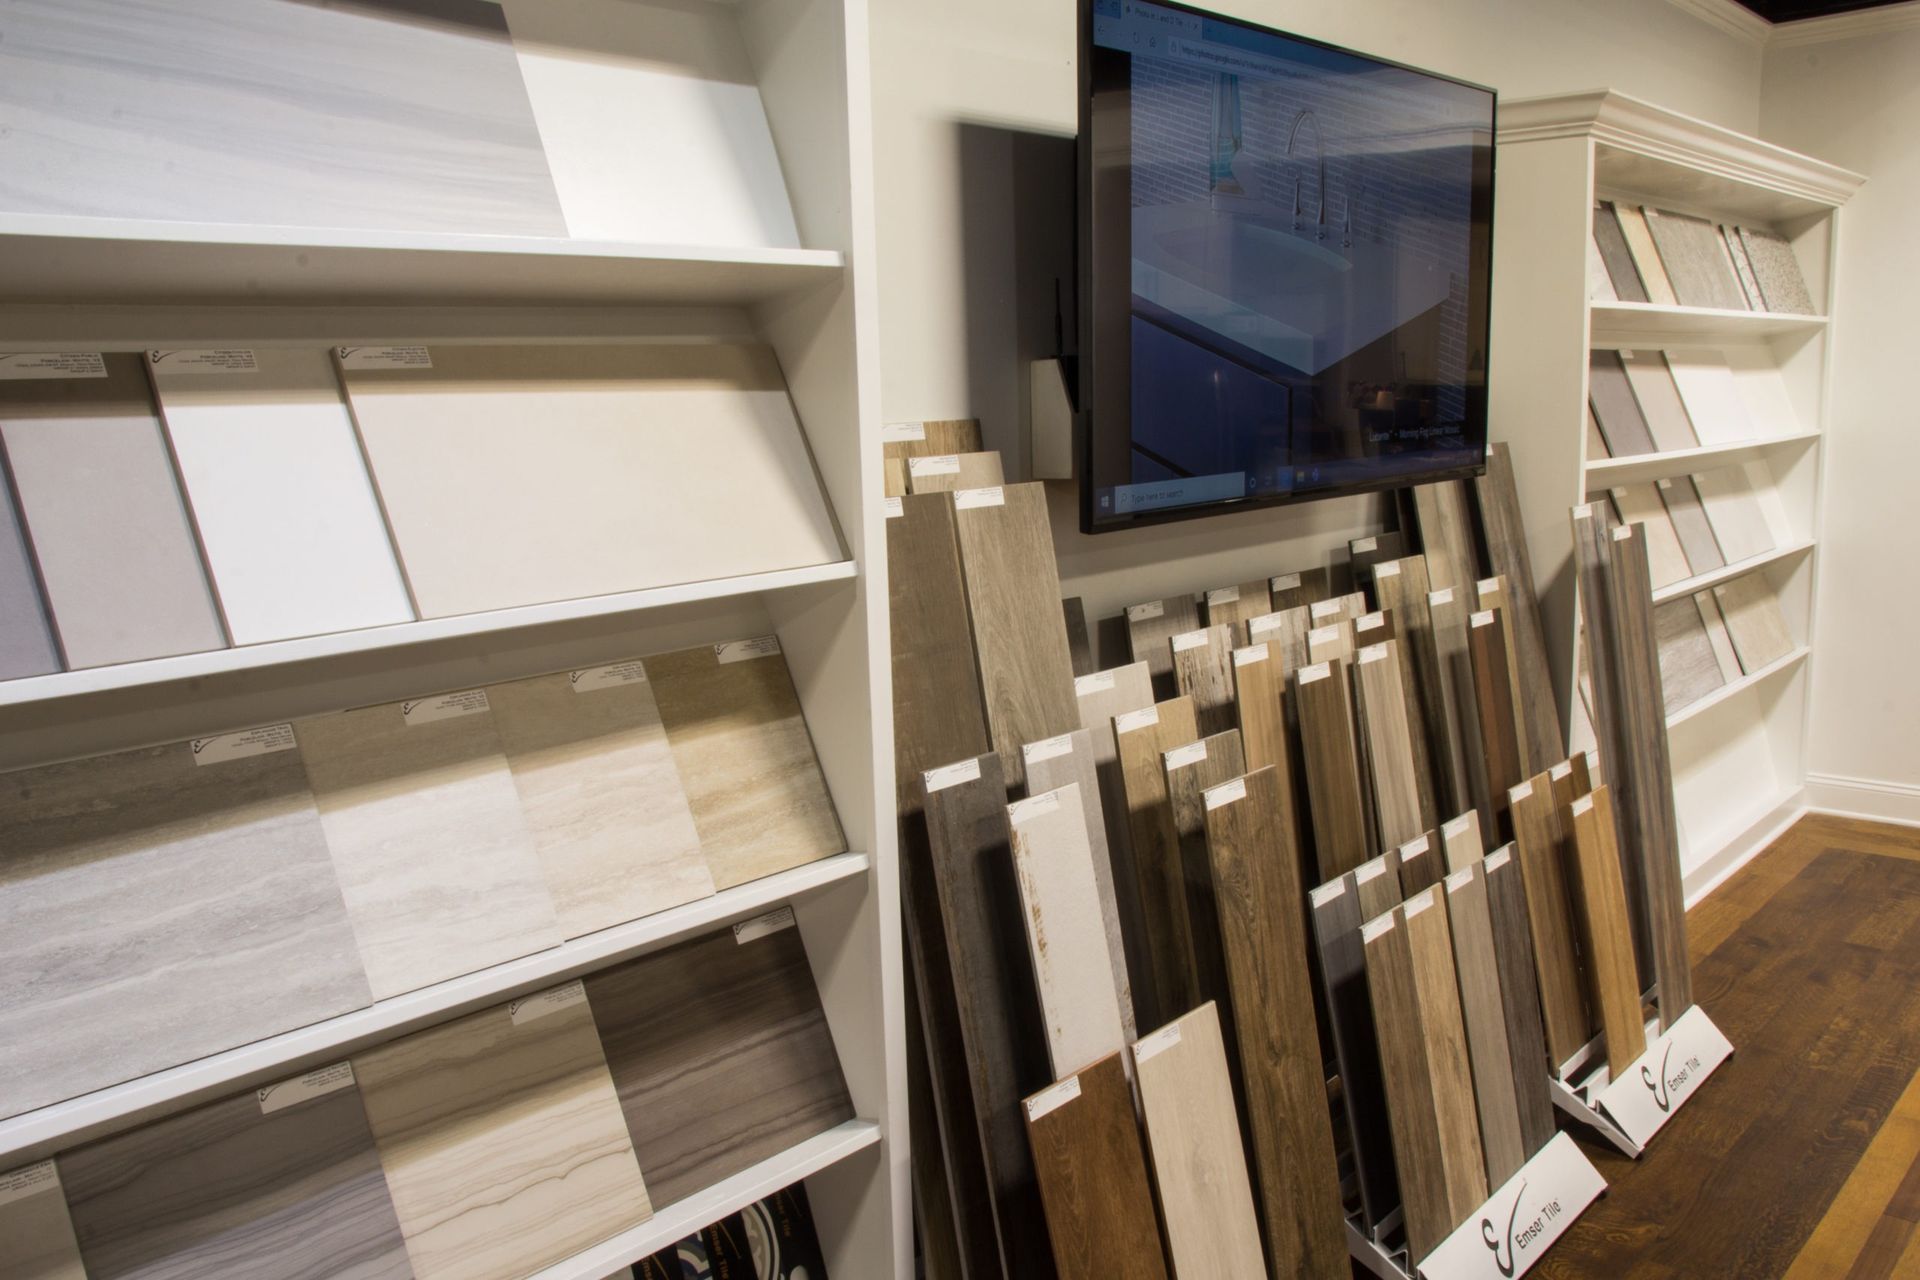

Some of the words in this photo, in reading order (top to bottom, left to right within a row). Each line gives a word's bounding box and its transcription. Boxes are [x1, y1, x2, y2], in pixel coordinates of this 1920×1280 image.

[1667, 1068, 1689, 1092] Emser
[1685, 1056, 1700, 1073] Tile
[1514, 1216, 1545, 1250] Emser
[1541, 1200, 1562, 1222] Tile
